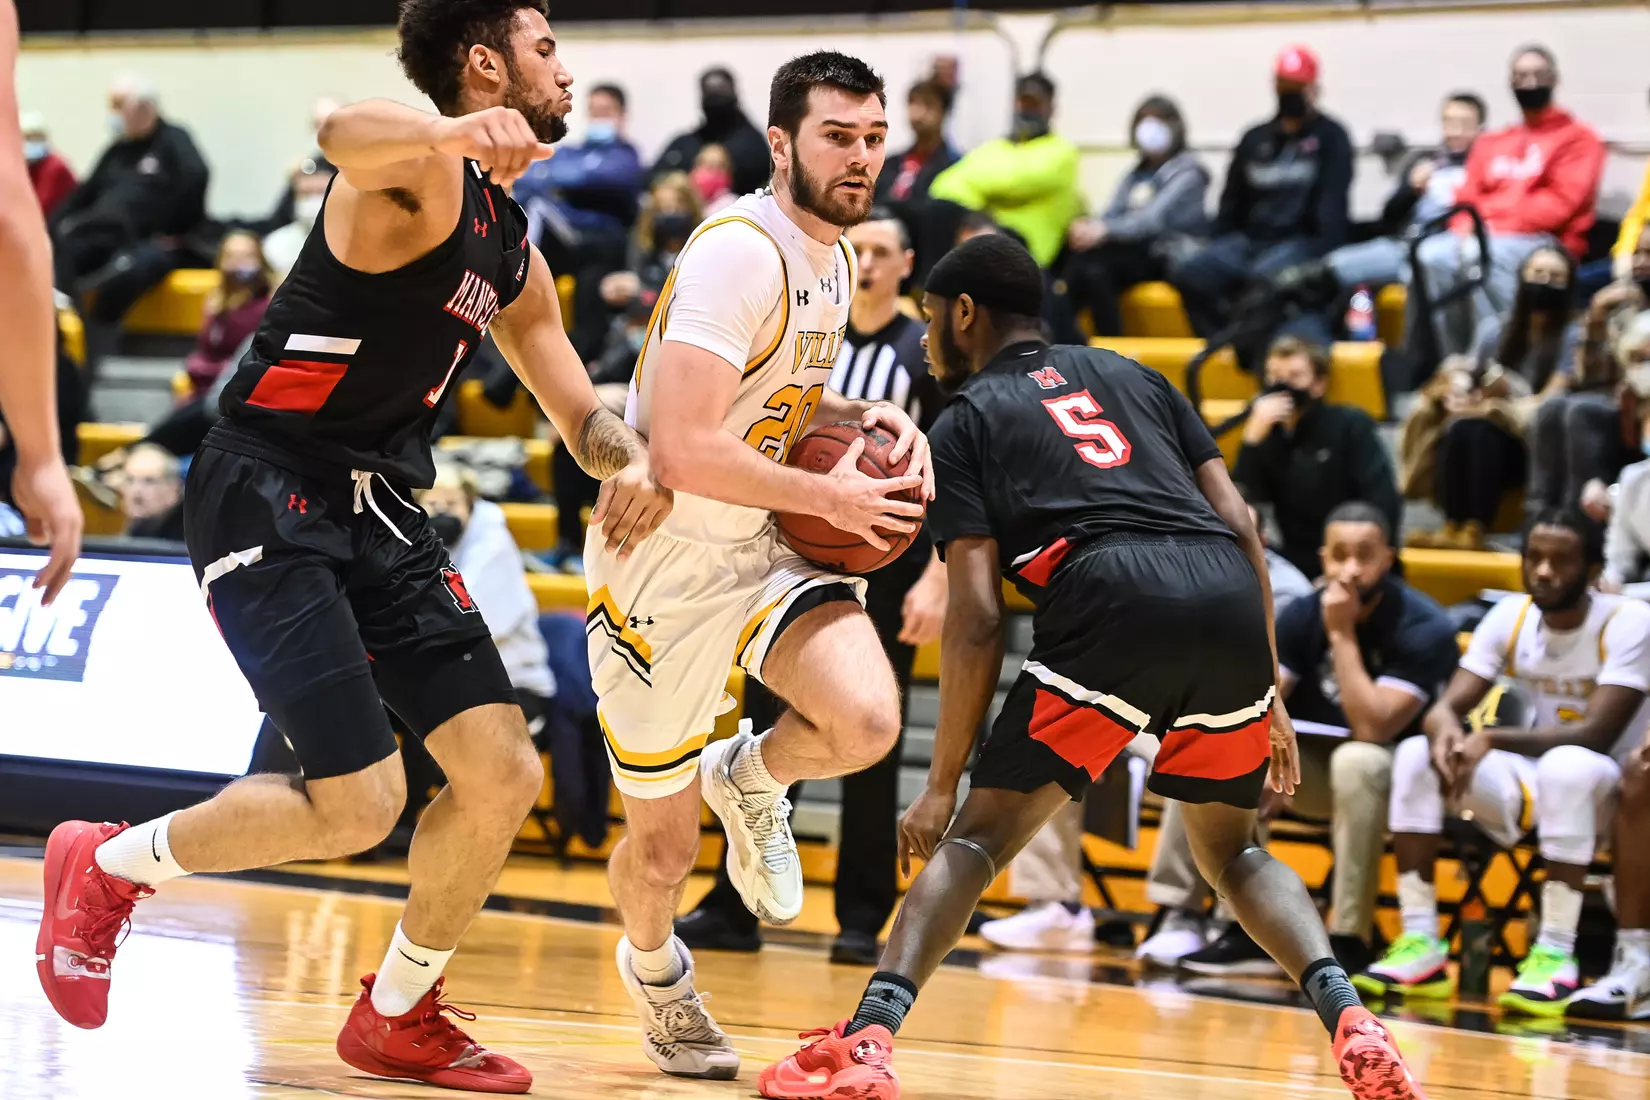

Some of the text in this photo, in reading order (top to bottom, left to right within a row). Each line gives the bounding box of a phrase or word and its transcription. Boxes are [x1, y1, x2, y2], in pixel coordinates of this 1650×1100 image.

[422, 339, 469, 409] 1
[1027, 366, 1068, 390] M
[743, 382, 825, 466] 20
[1040, 388, 1132, 469] 5
